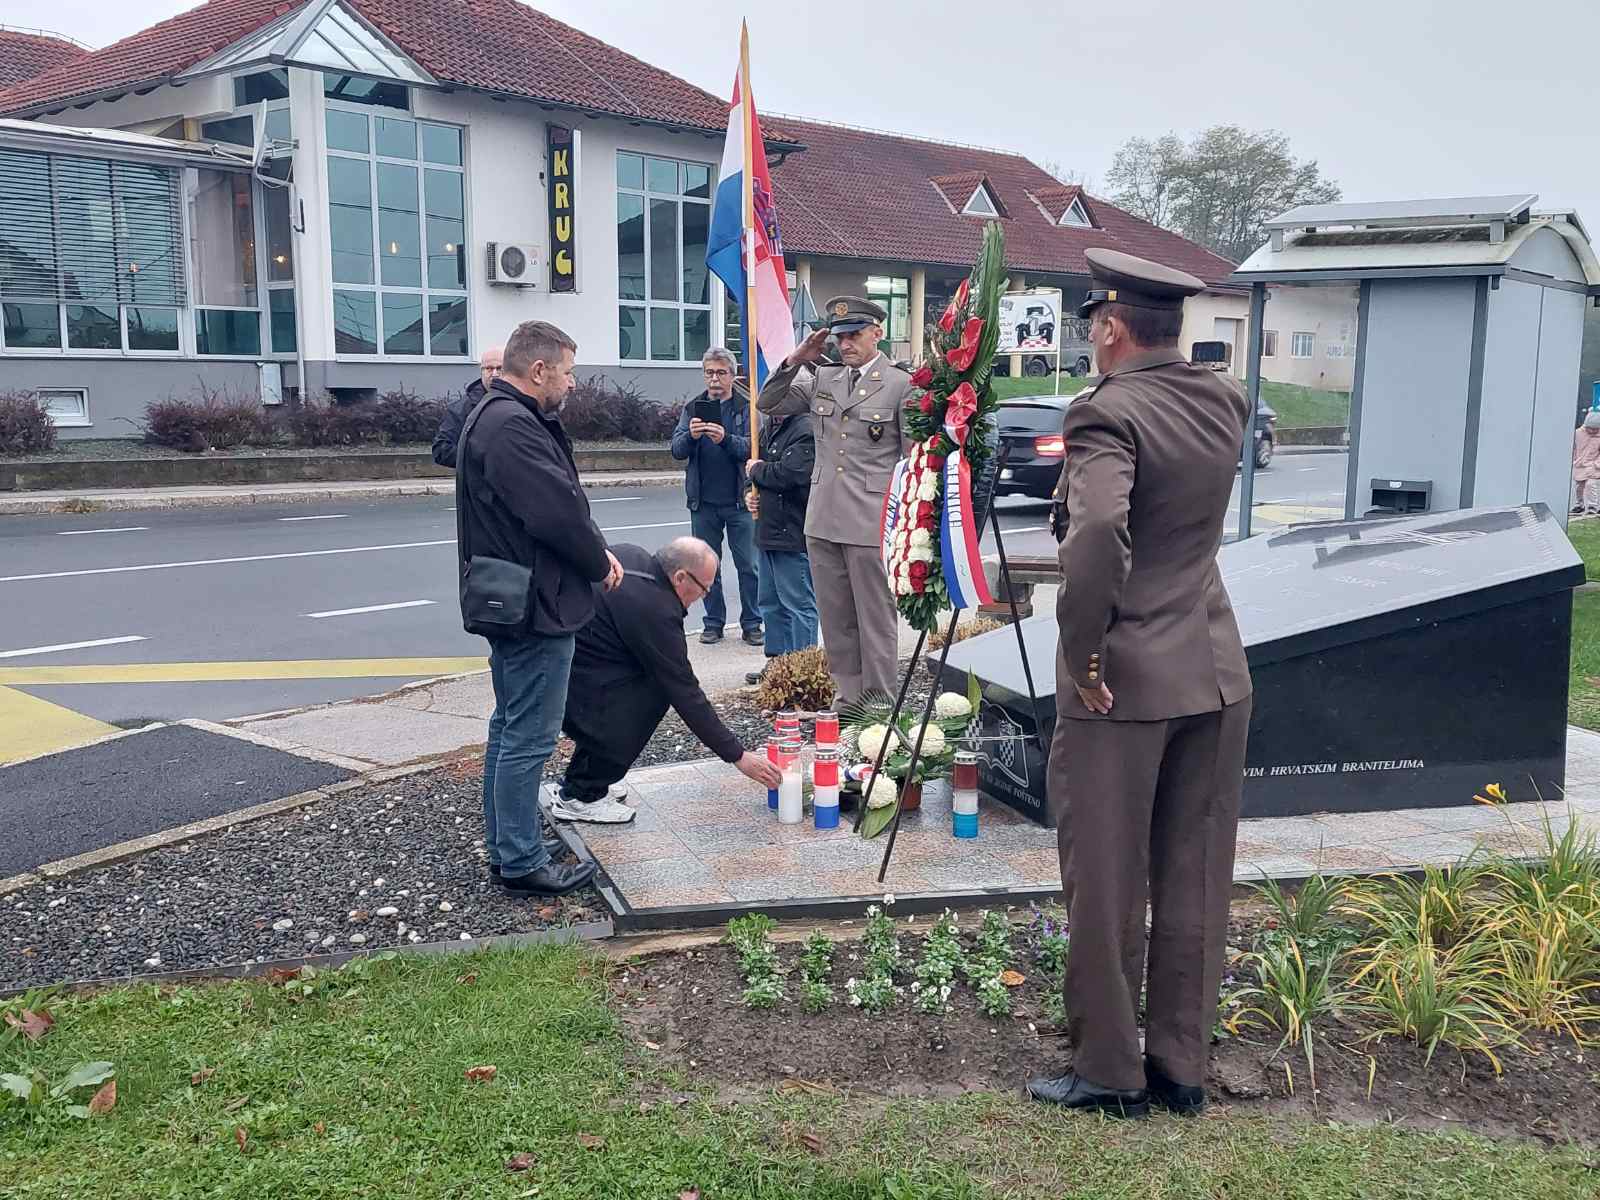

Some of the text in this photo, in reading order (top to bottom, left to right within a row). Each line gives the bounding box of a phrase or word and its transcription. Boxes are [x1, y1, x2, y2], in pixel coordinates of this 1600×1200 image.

[553, 149, 572, 275] KRUG
[1242, 759, 1424, 777] VIM HRVATSKIM BRANITELJIMA
